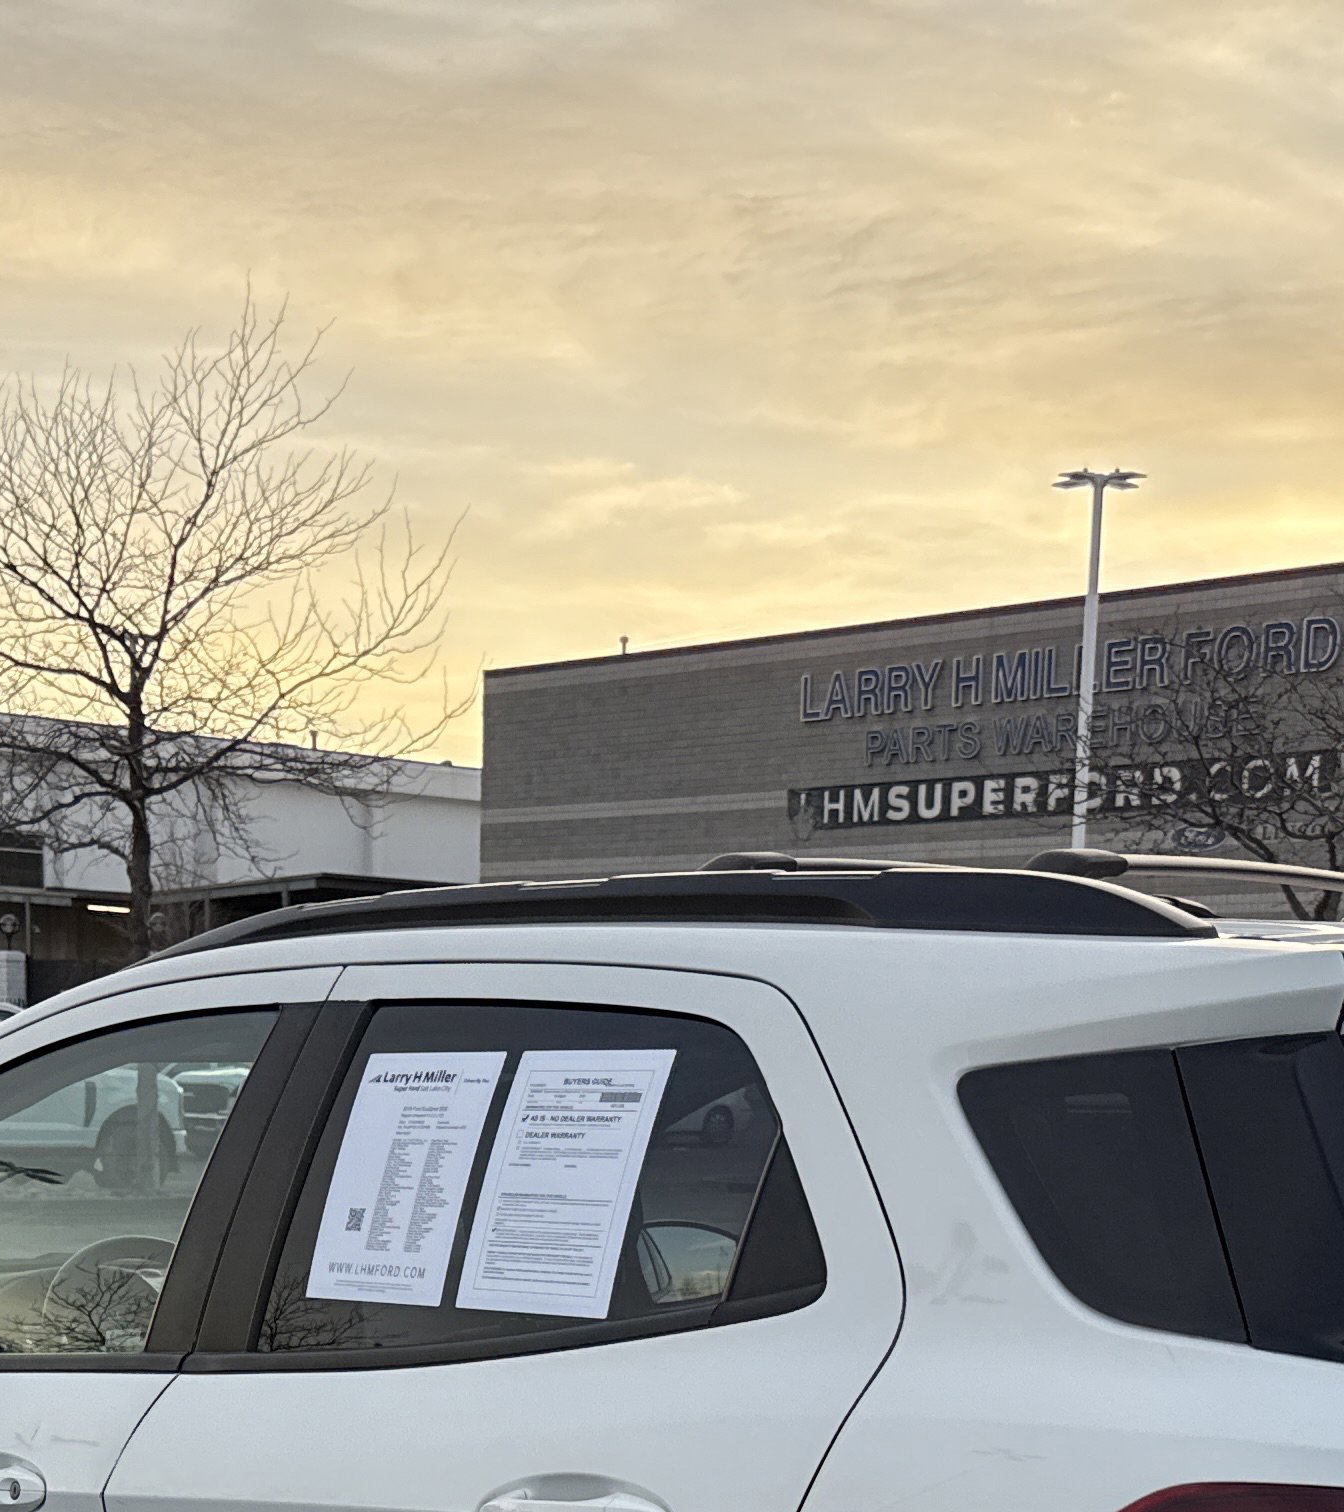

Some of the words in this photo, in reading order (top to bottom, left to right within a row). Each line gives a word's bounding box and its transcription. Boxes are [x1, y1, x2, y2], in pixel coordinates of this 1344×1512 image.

[799, 658, 944, 723] LARRY
[951, 654, 984, 708] H
[1178, 614, 1343, 685] FORD
[863, 720, 983, 768] PARTS
[990, 696, 1262, 757] WAREHOUSE
[383, 1071, 413, 1085] Larry
[413, 1071, 423, 1083] H
[424, 1069, 457, 1083] Miller
[328, 1261, 426, 1279] WWW.LHMFORD.COM
